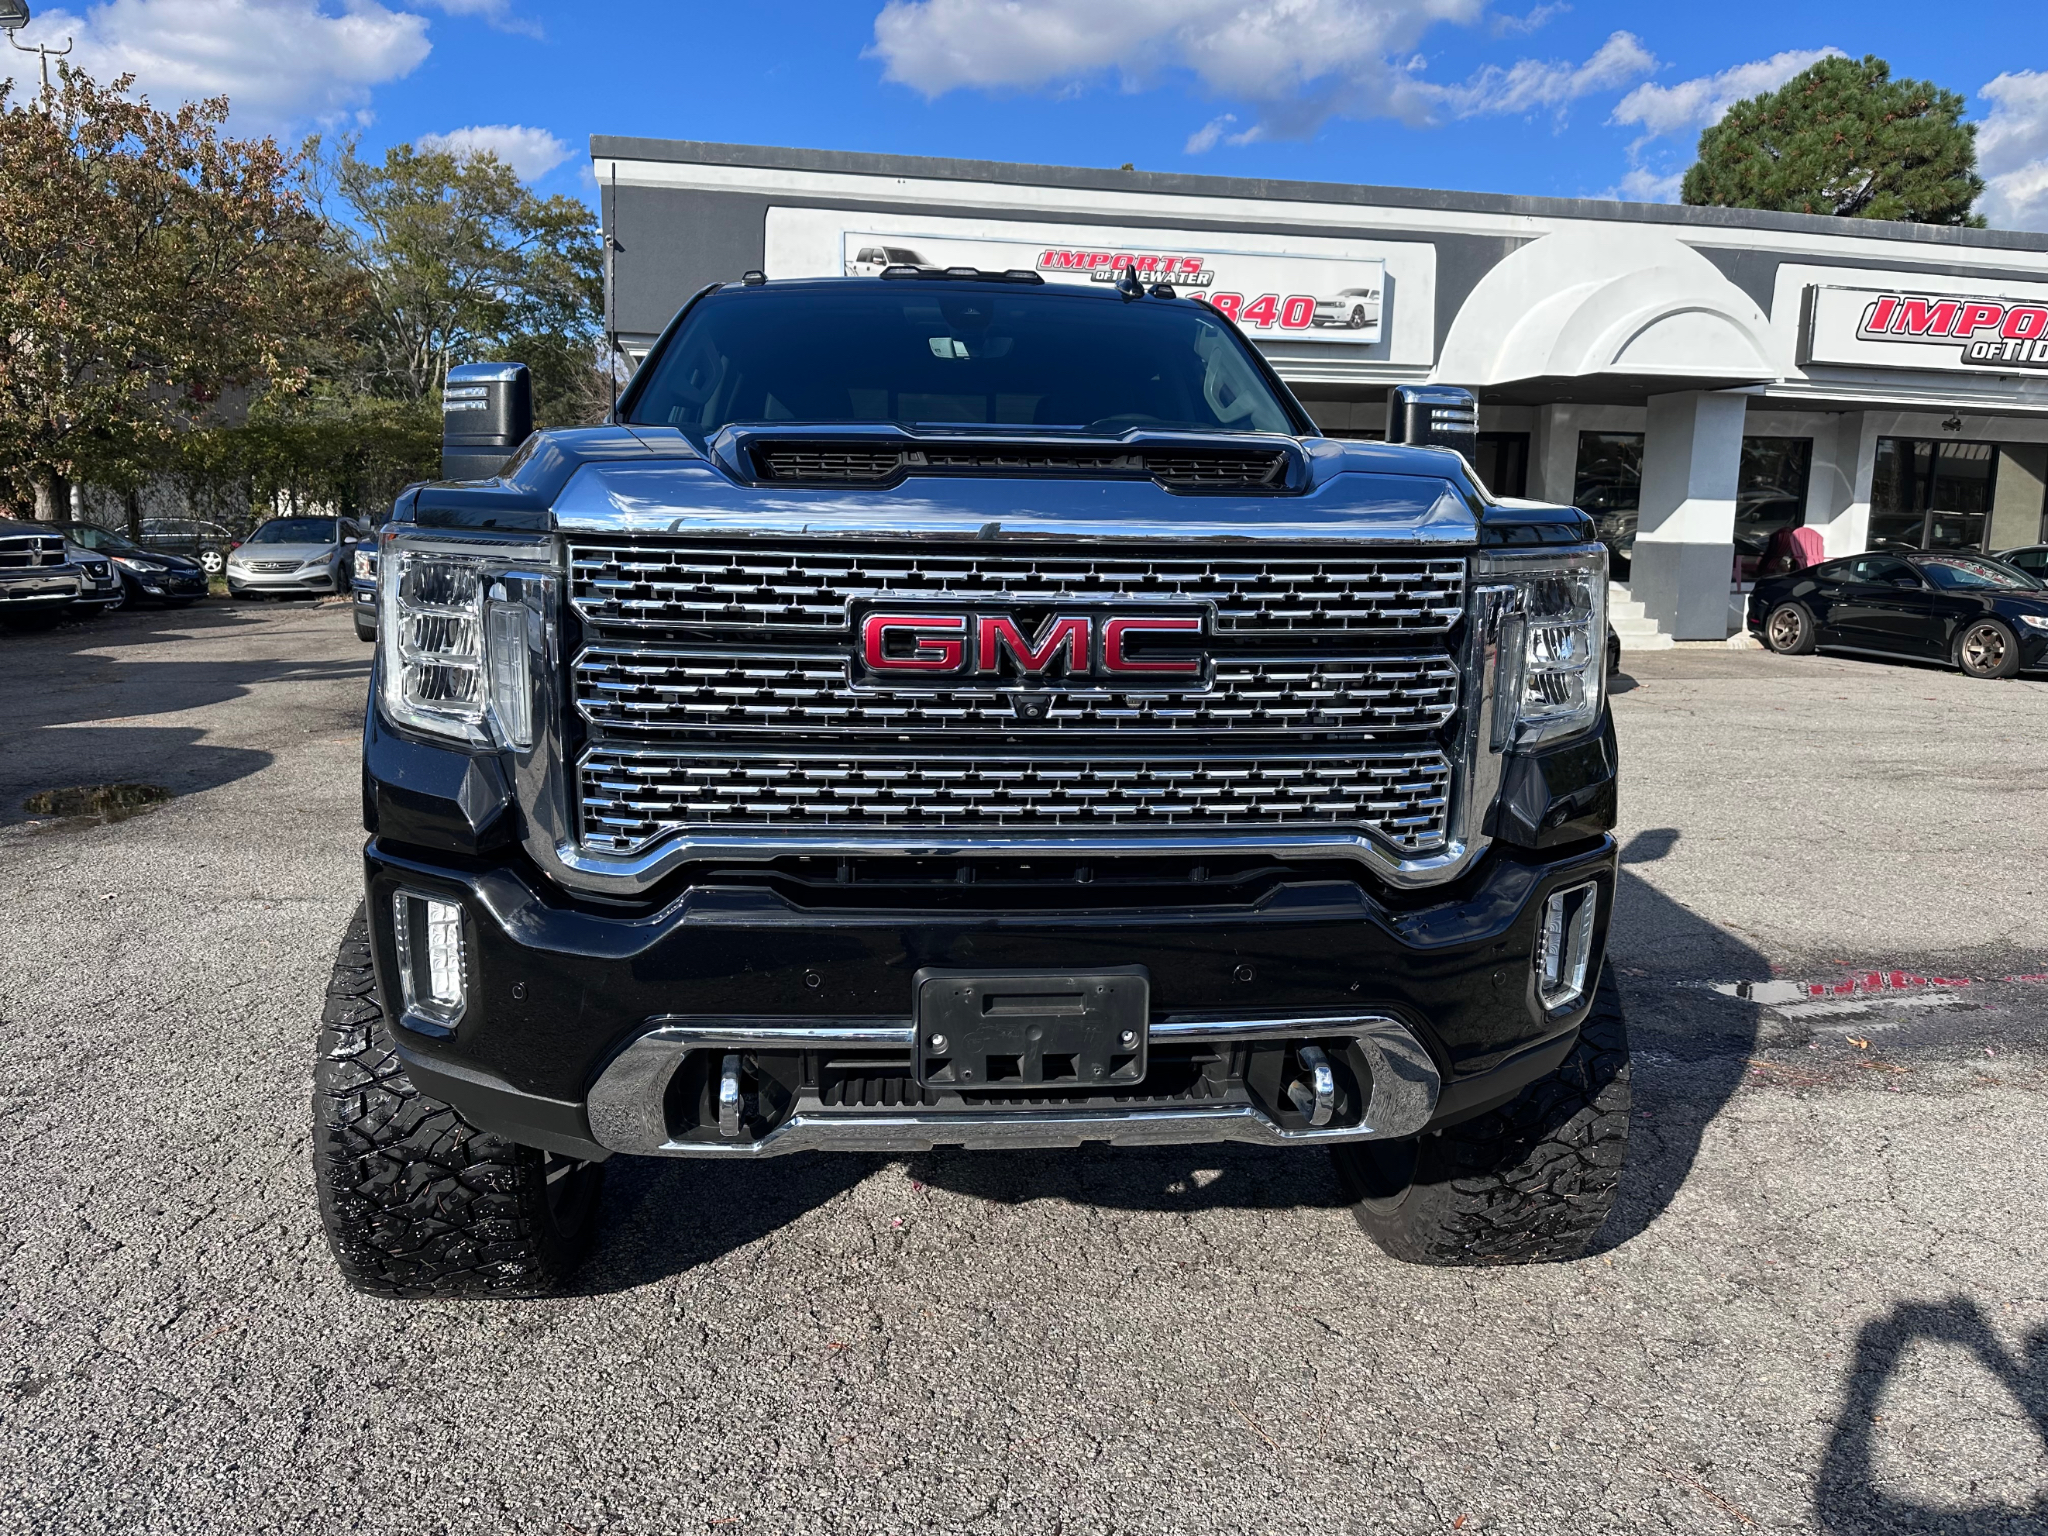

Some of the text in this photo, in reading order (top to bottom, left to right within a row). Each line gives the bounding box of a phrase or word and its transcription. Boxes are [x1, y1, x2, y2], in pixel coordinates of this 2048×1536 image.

[1041, 250, 1204, 274] IMPORTS
[1111, 269, 1210, 285] TIEWATER
[1866, 297, 2048, 338] IMPO
[861, 611, 1202, 676] GMC
